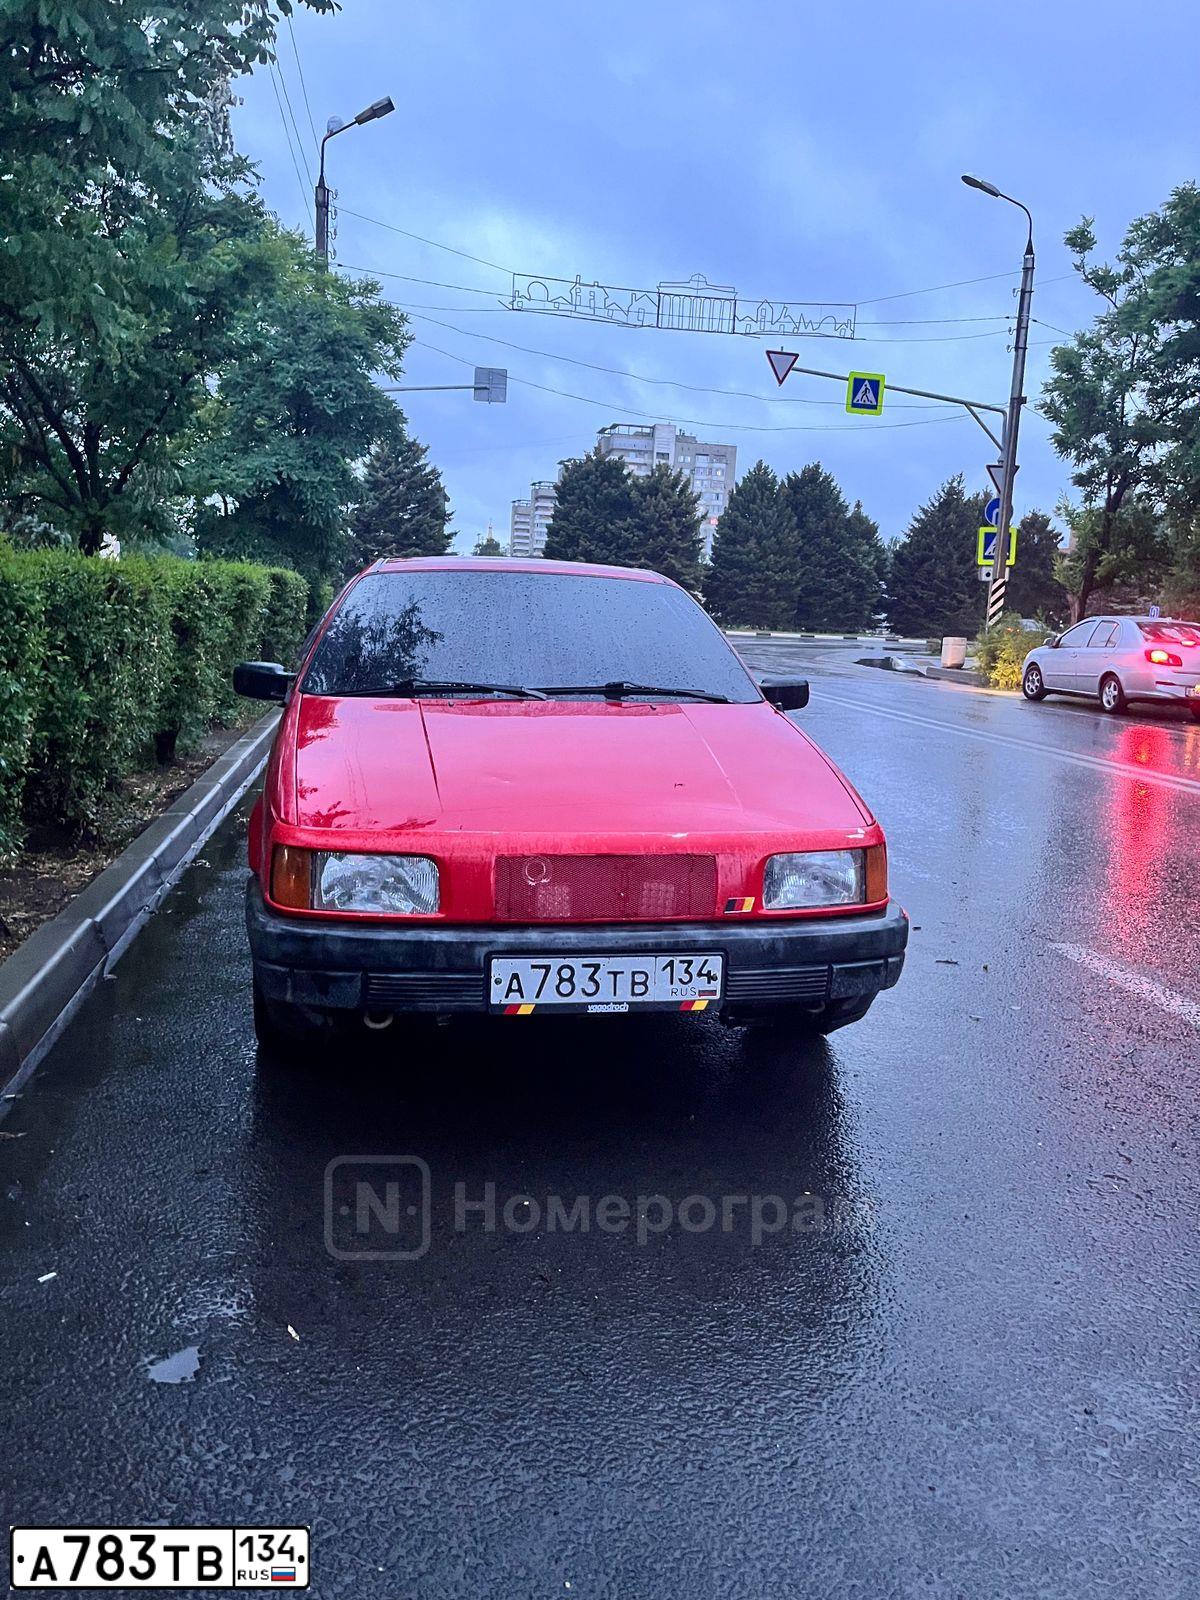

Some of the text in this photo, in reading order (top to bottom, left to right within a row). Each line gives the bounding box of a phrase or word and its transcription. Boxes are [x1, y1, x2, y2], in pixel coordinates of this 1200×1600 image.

[504, 958, 713, 1000] А783ТВ 134
[670, 987, 697, 997] RUS
